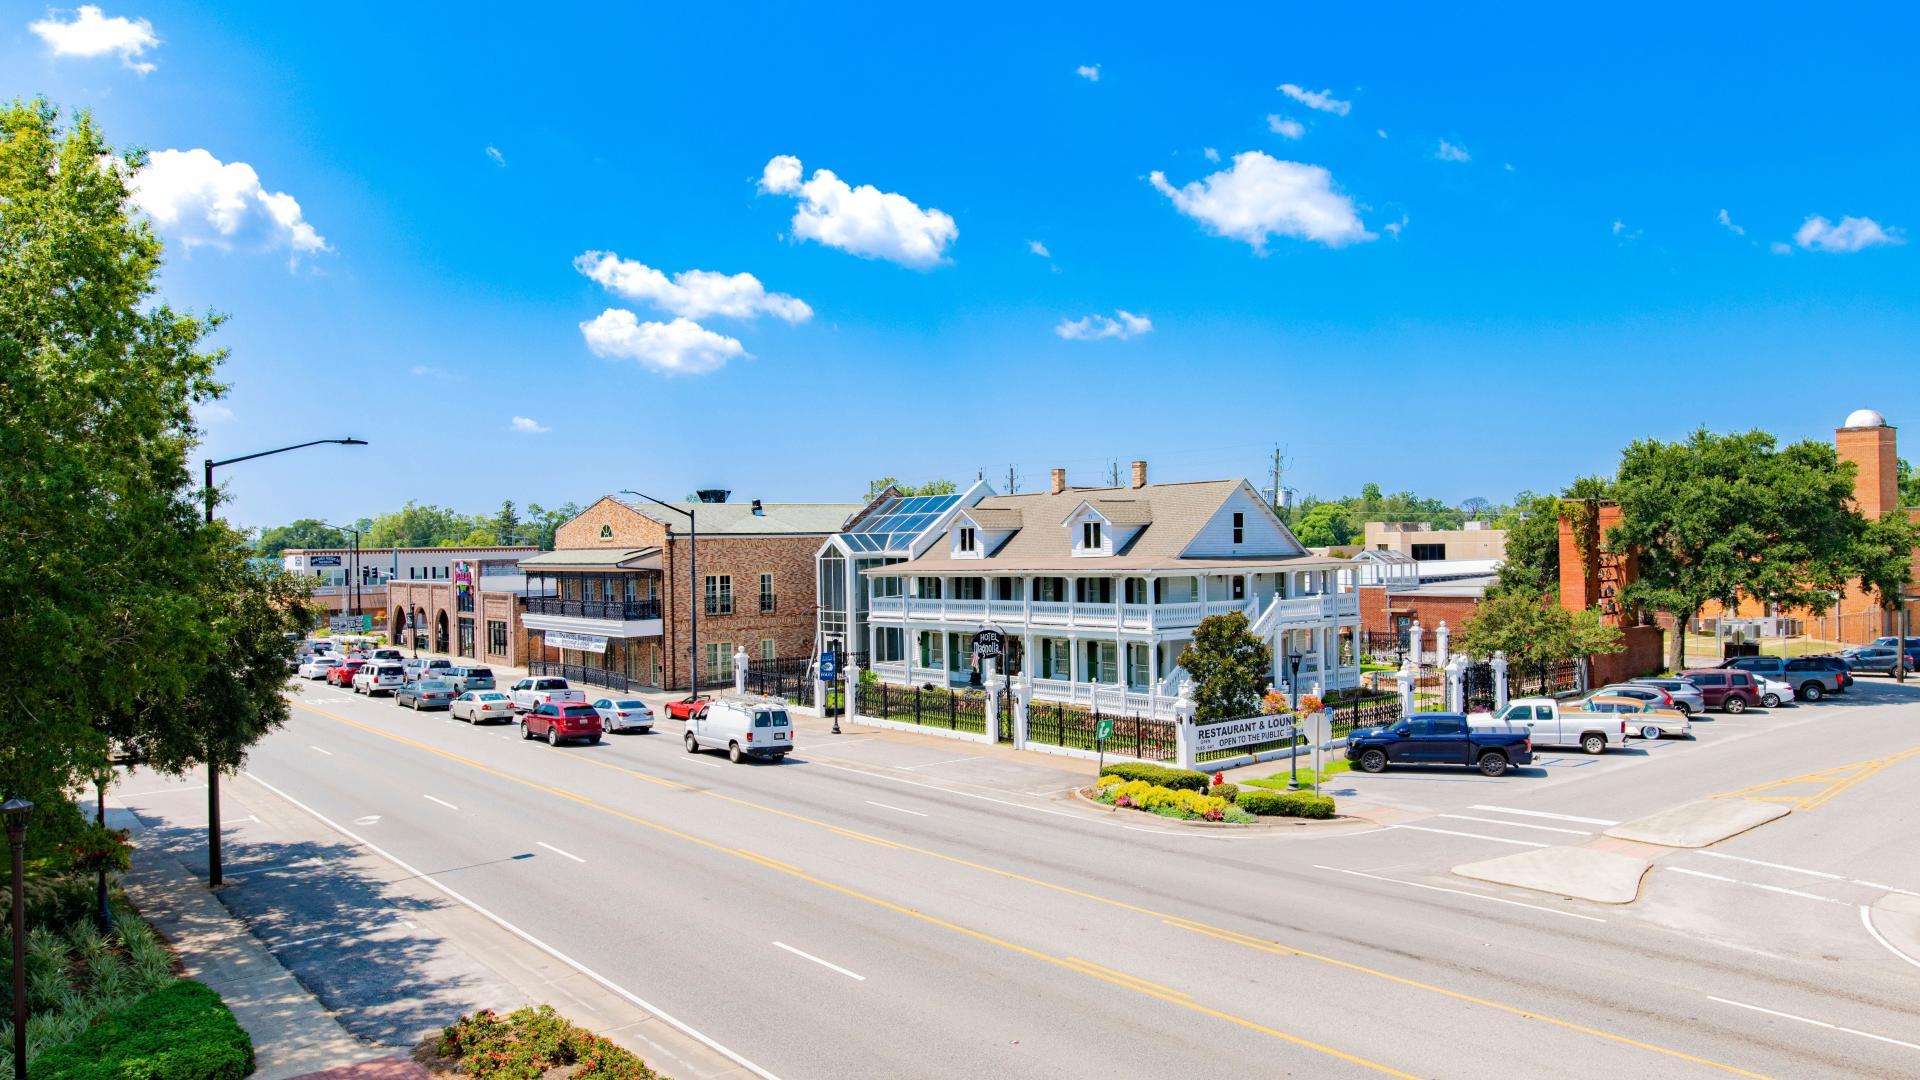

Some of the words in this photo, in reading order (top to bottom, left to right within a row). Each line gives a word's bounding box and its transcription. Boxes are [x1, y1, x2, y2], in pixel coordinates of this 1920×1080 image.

[980, 632, 999, 643] HOTEL
[973, 641, 999, 657] Magnolia
[1198, 722, 1256, 739] RESTAURANT
[1259, 721, 1265, 730] &
[1268, 717, 1294, 729] LOUN
[1219, 737, 1237, 747] OPEN
[1248, 734, 1260, 742] THE
[1262, 729, 1285, 740] PUBLIC
